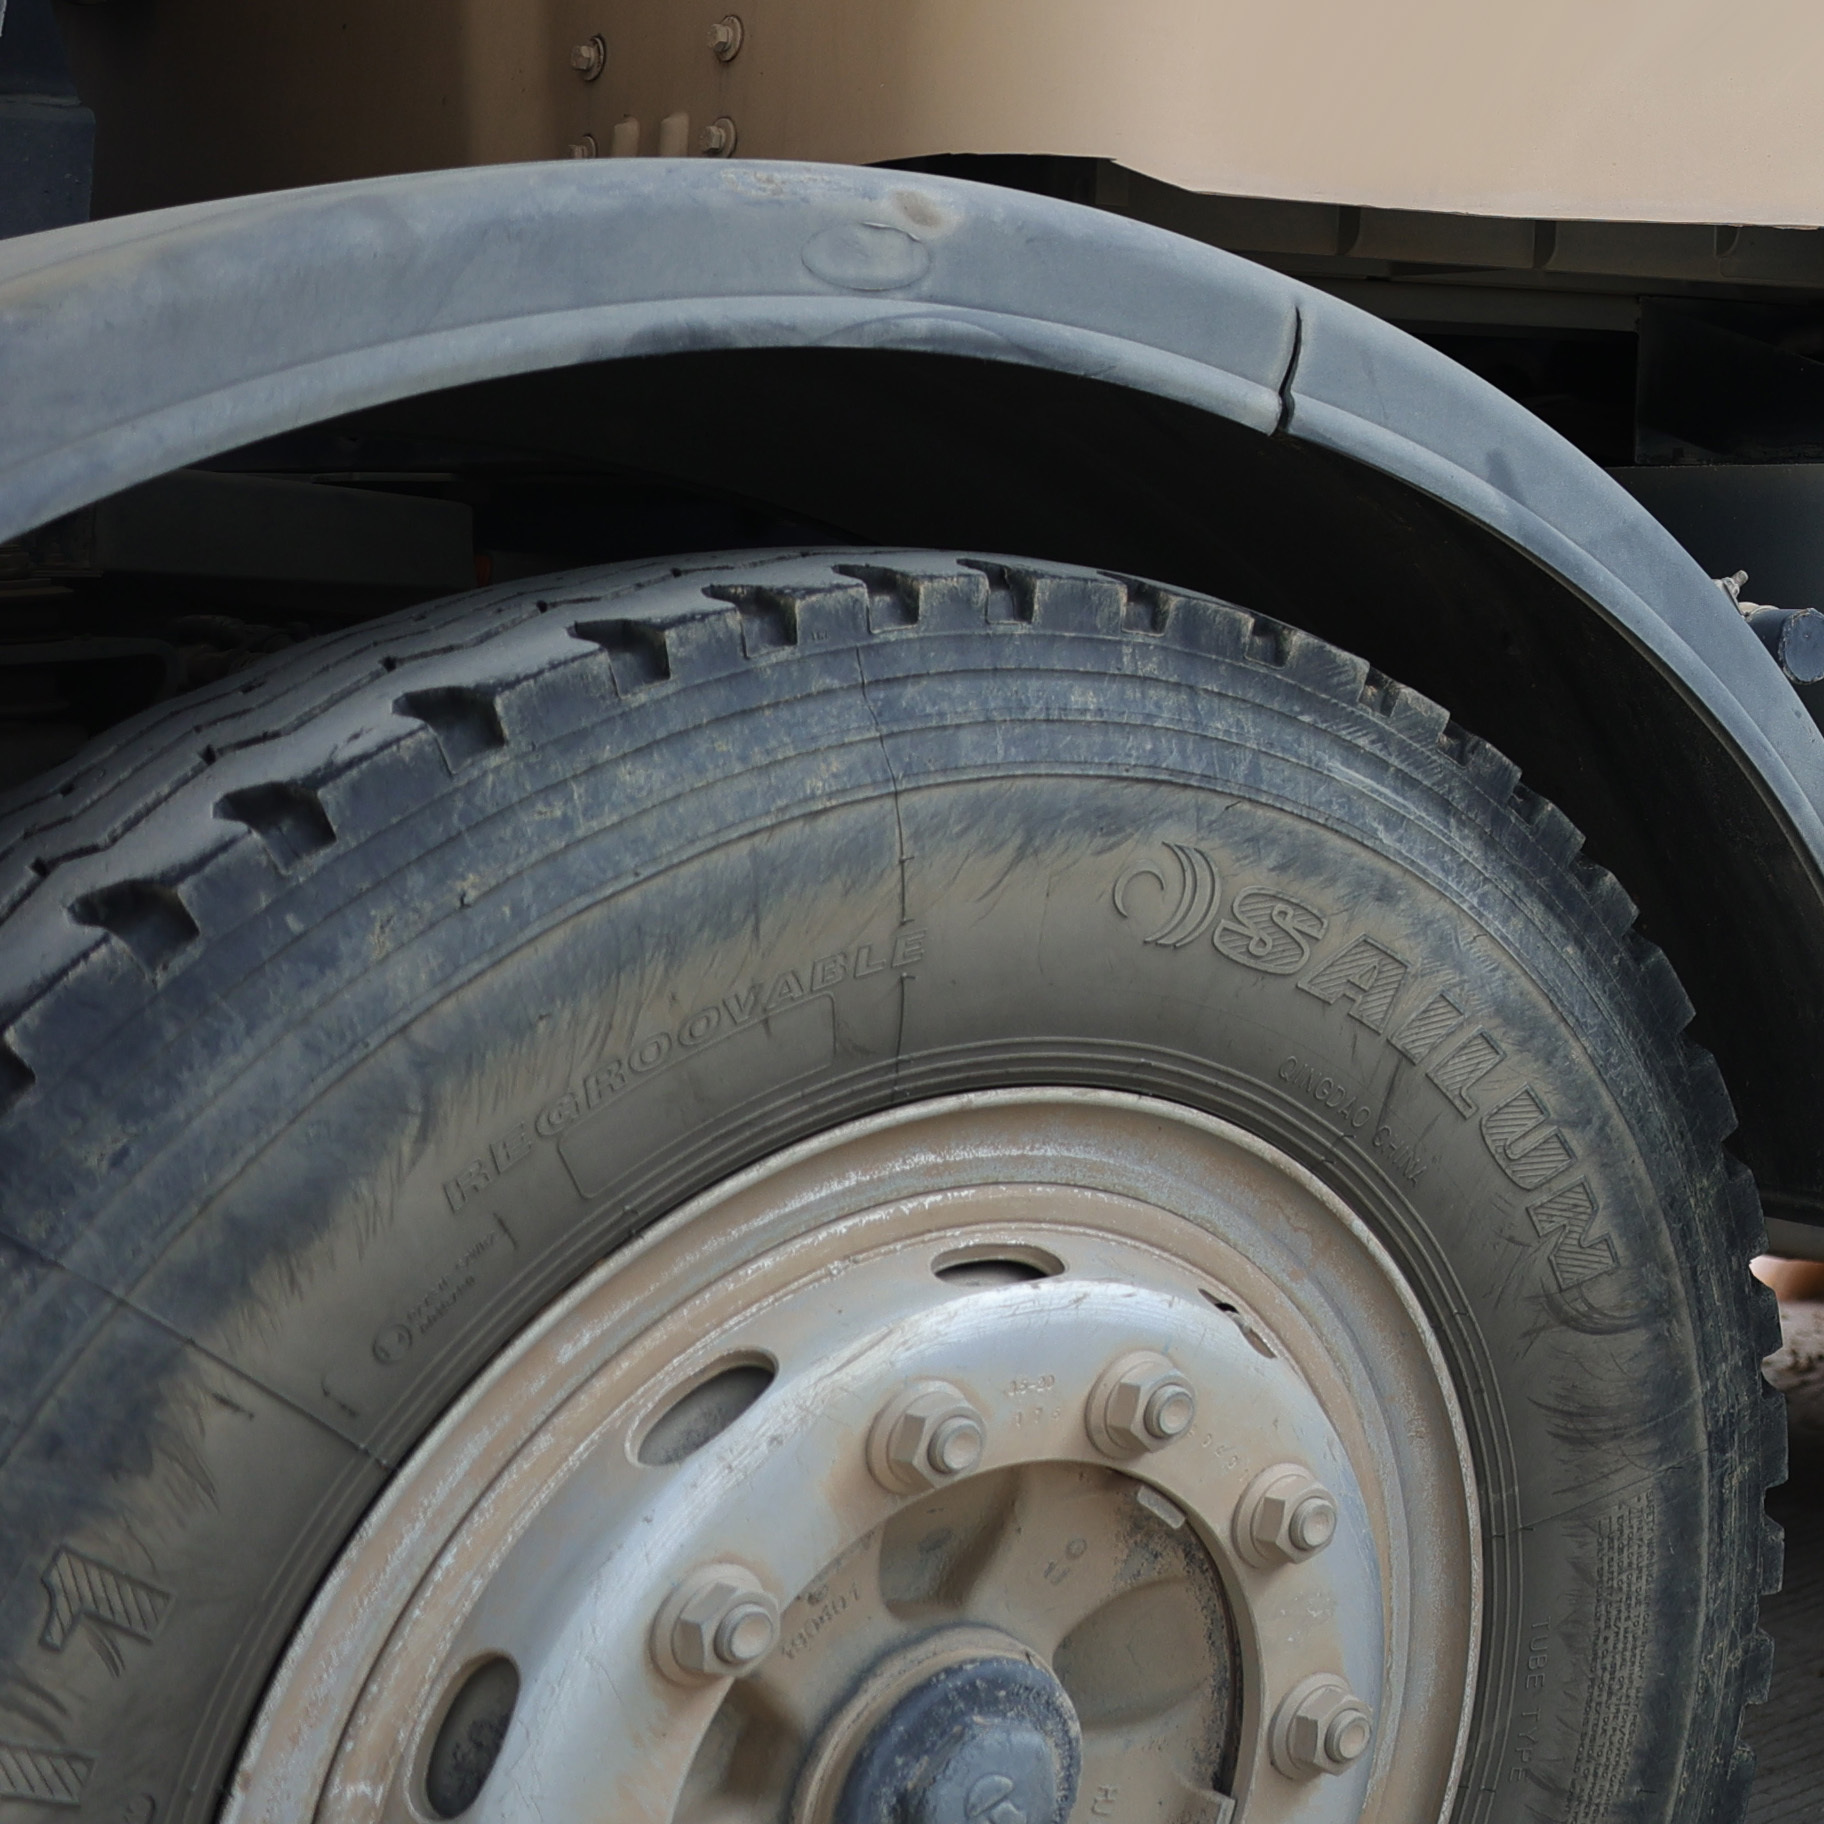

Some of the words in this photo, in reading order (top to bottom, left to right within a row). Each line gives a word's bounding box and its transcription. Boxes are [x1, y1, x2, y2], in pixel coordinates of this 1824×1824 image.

[441, 929, 927, 1213] REGROOVABLE
[1212, 885, 1620, 1293] SAILUN
[1279, 1055, 1371, 1127] QINGDAO
[1526, 1617, 1551, 1689] TUBE
[1511, 1707, 1542, 1782] TYPE
